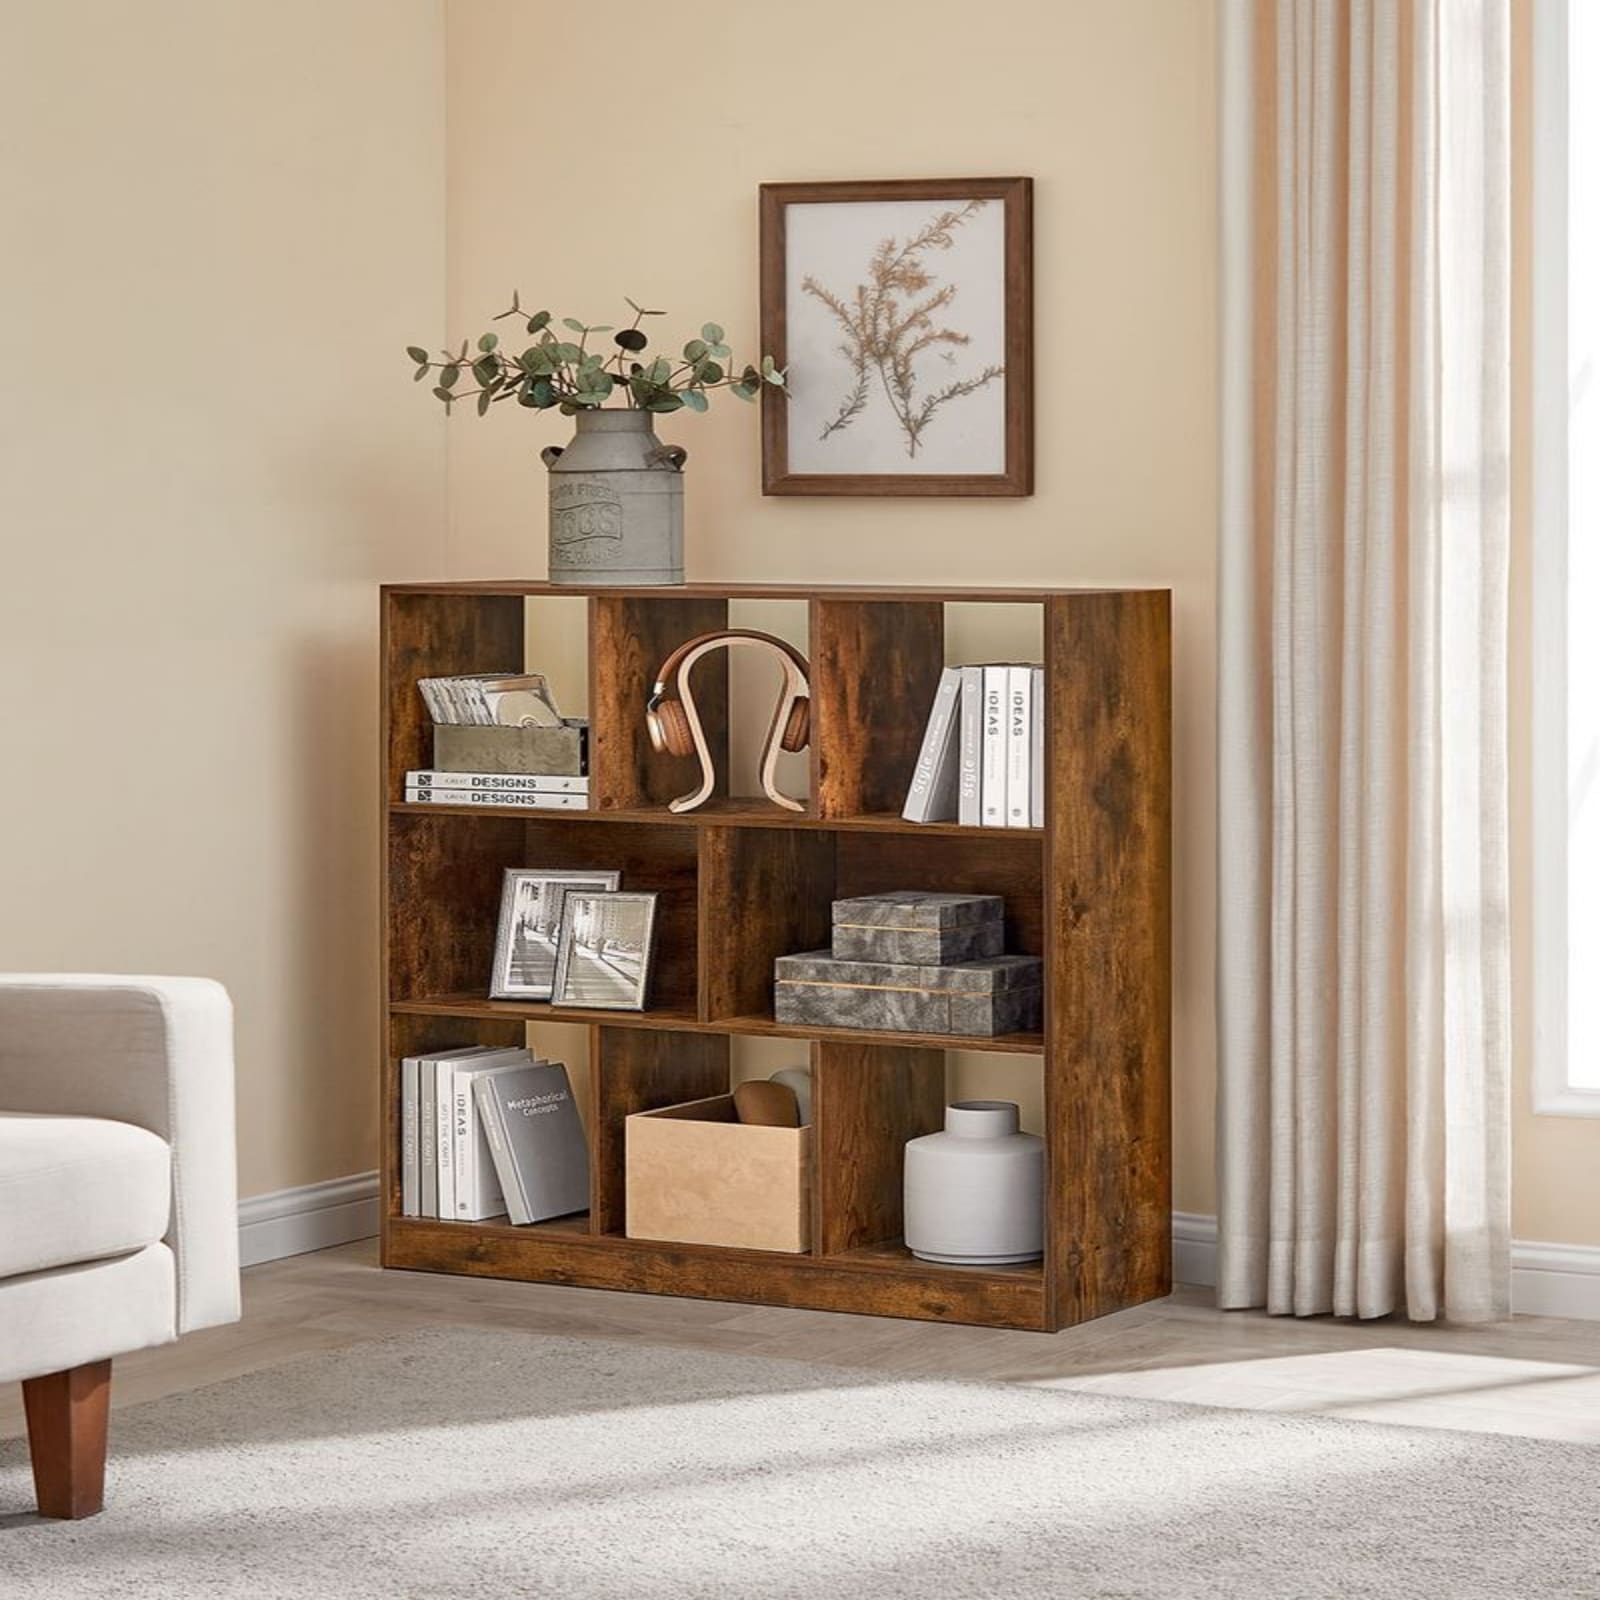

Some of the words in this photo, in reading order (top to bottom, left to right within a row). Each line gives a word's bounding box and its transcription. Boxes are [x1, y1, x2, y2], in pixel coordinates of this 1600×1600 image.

[988, 690, 999, 736] IDEAS
[1013, 691, 1024, 736] IDEAS
[471, 776, 537, 790] DESIGNS
[913, 757, 933, 794] Style
[962, 760, 977, 799] Style
[471, 792, 536, 806] DESIGNS
[456, 1093, 467, 1136] IDEAS
[506, 1089, 568, 1111] Metaphorical
